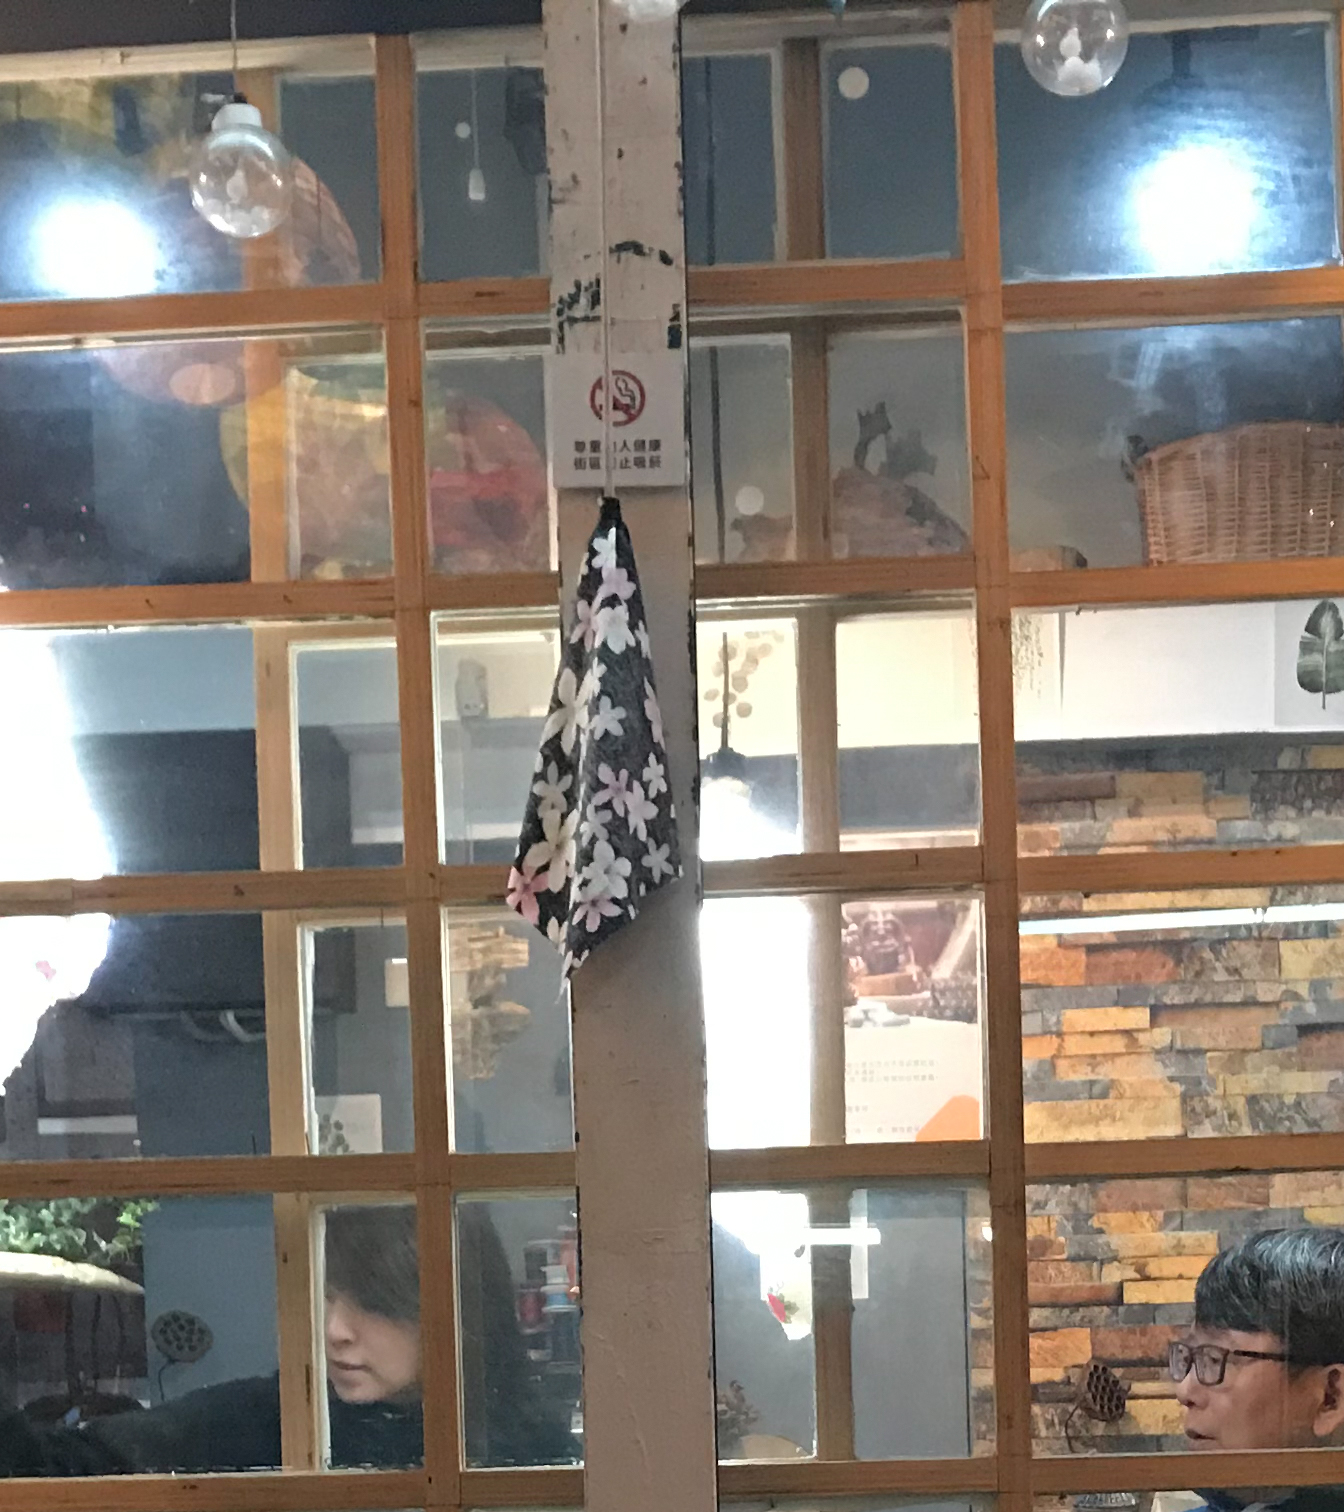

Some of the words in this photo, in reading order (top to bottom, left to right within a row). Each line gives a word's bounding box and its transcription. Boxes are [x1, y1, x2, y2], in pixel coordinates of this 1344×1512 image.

[574, 455, 662, 471] 街區止吸菸
